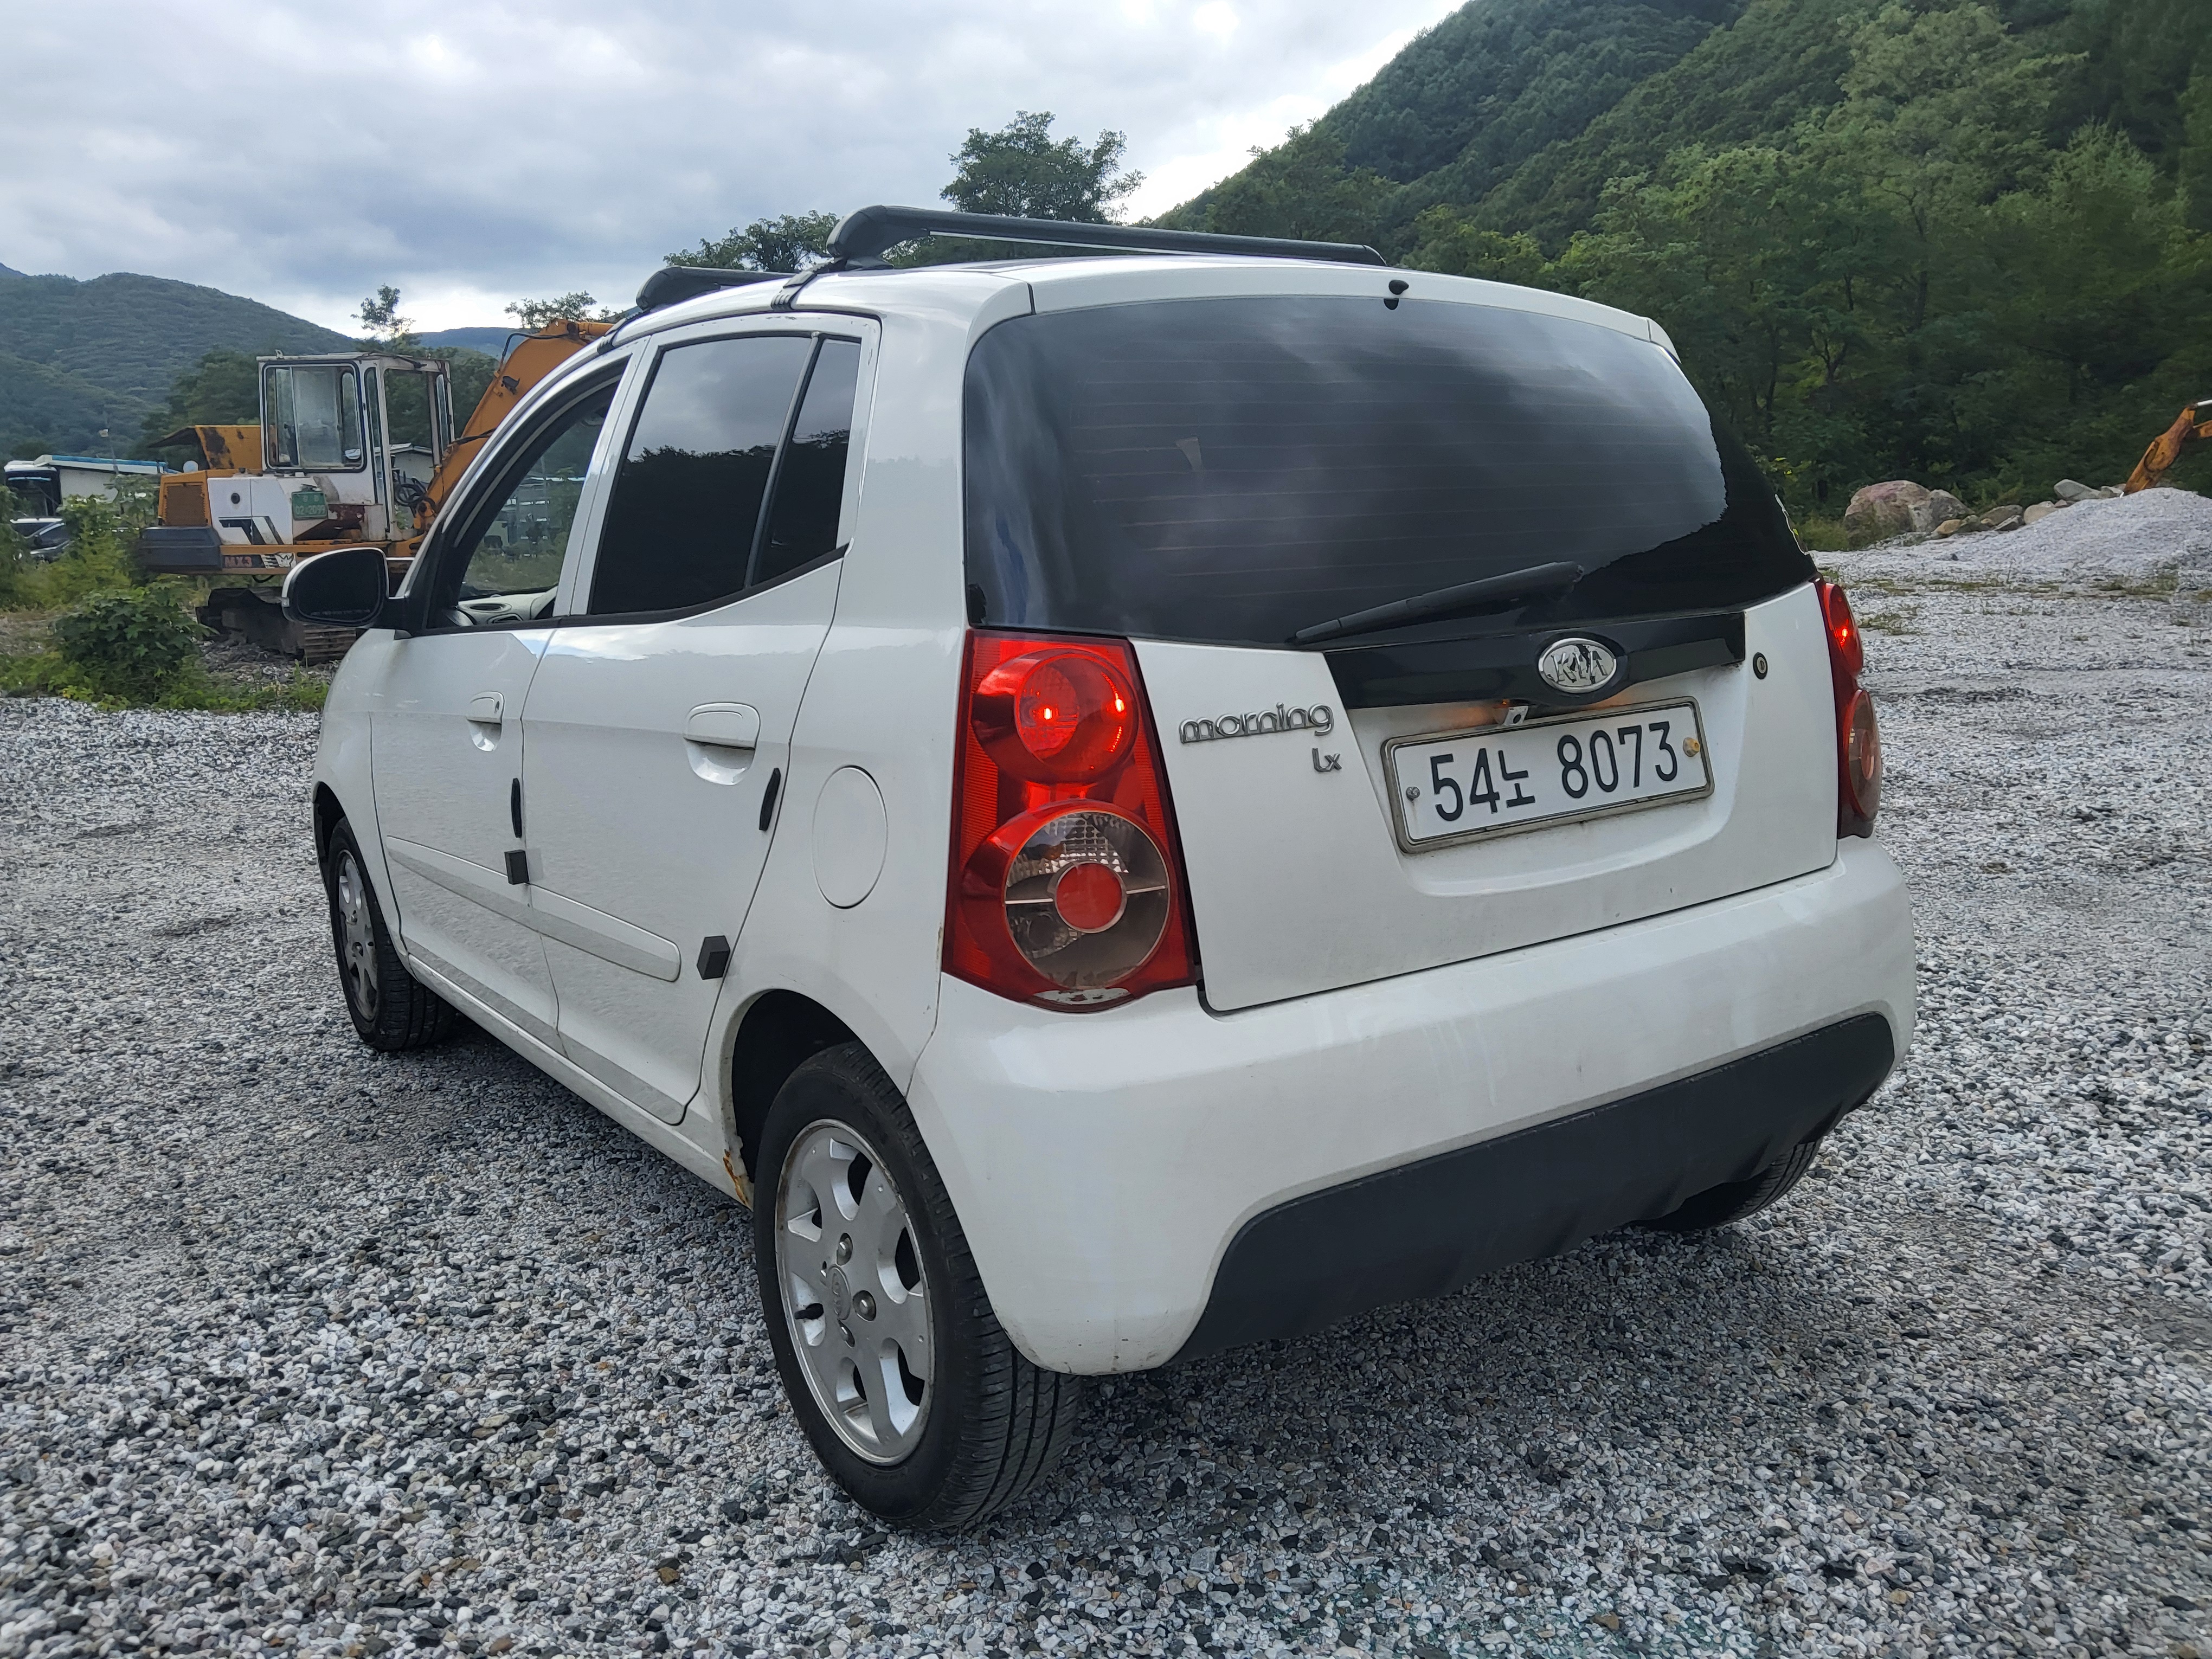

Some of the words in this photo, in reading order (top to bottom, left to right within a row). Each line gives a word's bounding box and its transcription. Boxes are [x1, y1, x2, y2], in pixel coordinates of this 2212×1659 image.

[224, 556, 253, 568] MX3
[1550, 651, 1609, 682] KIA
[1179, 703, 1334, 743] morning
[1430, 748, 1536, 821] 54노
[1557, 721, 1678, 799] 8073
